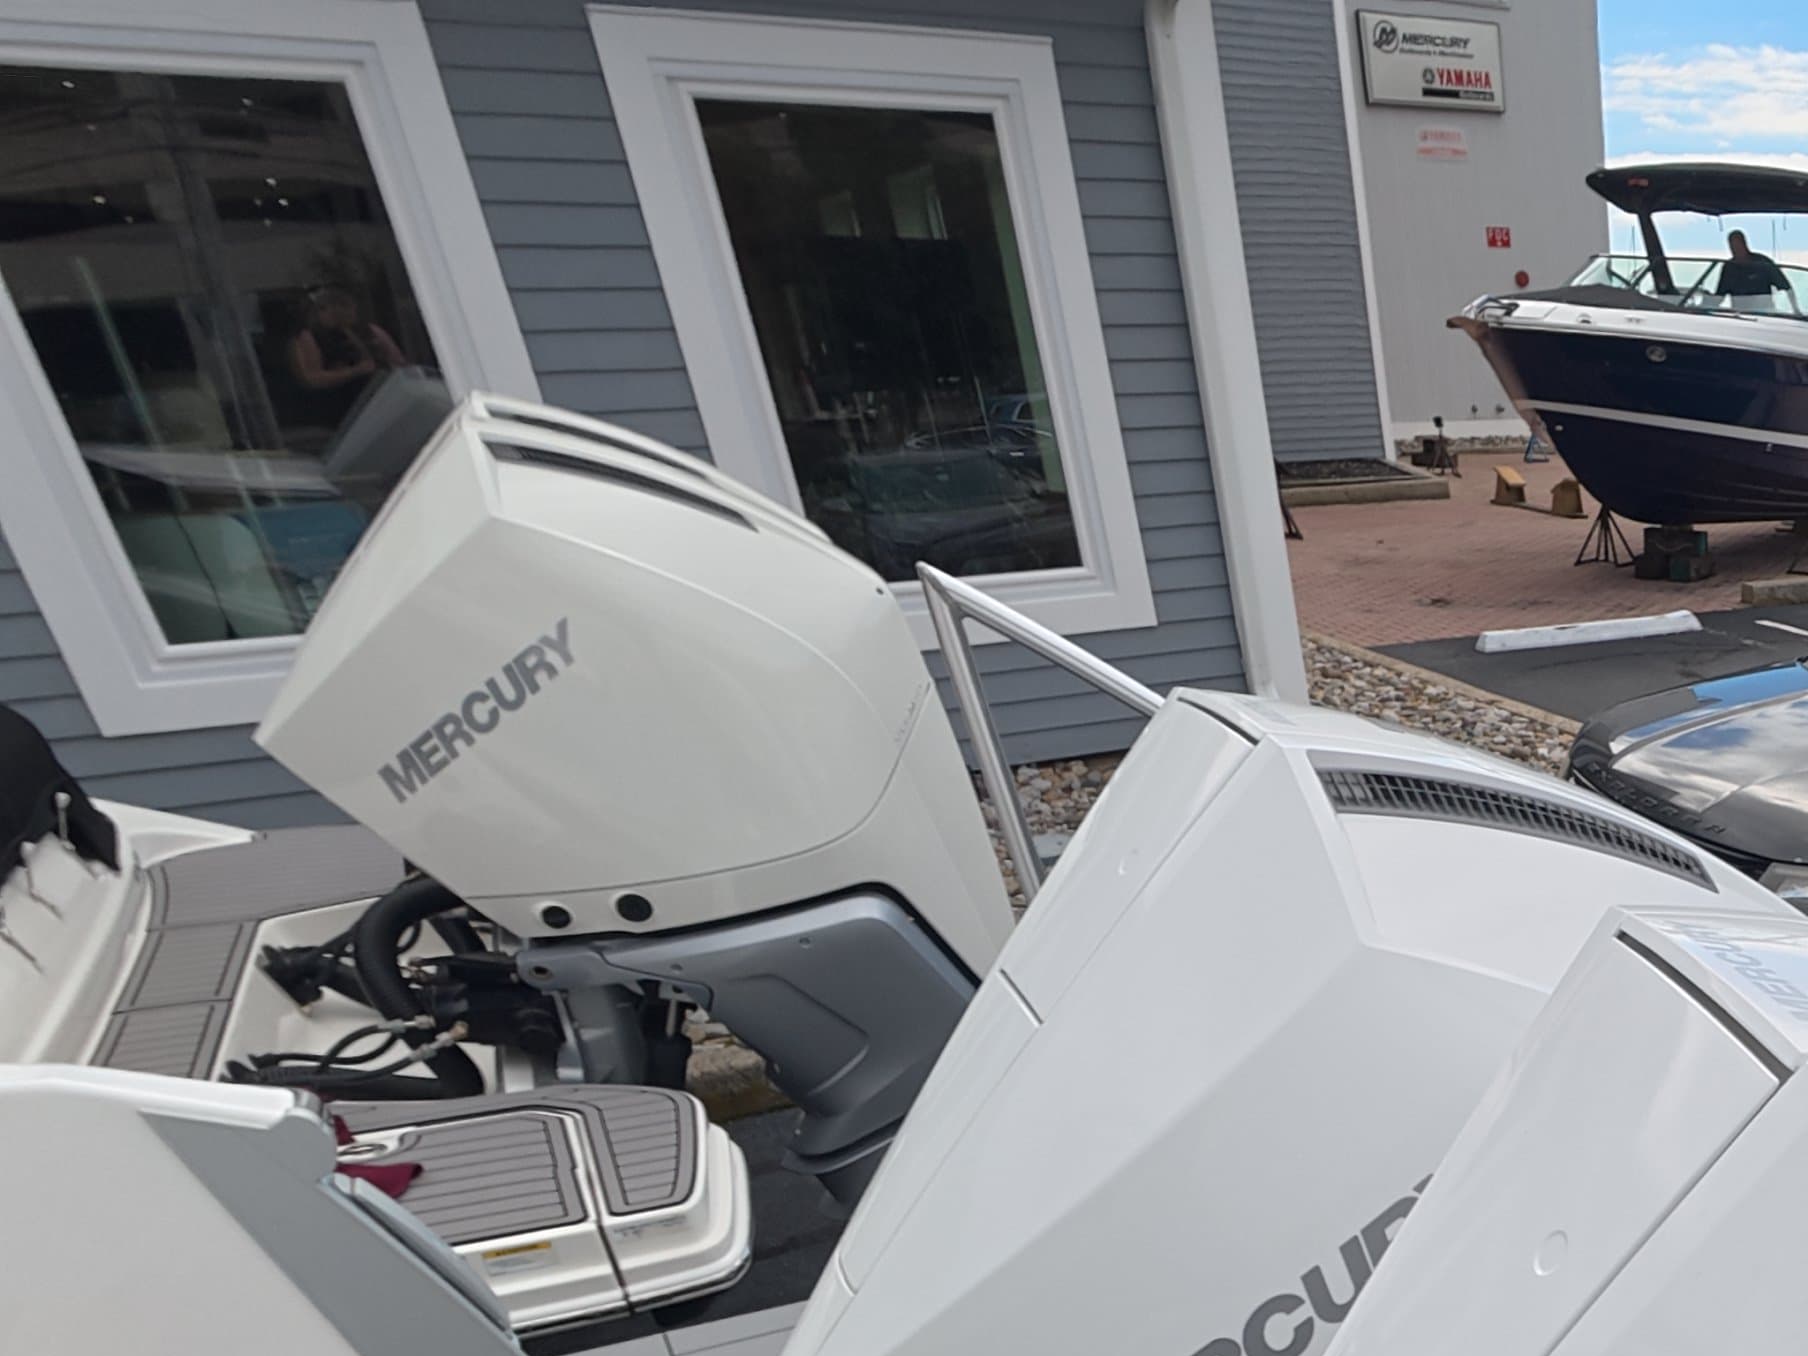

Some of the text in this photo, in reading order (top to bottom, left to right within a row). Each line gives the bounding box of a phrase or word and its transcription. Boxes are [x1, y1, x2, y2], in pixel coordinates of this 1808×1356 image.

[1401, 32, 1470, 49] MERCURY
[1436, 68, 1492, 89] YAMAHA
[377, 616, 575, 804] MERCURY
